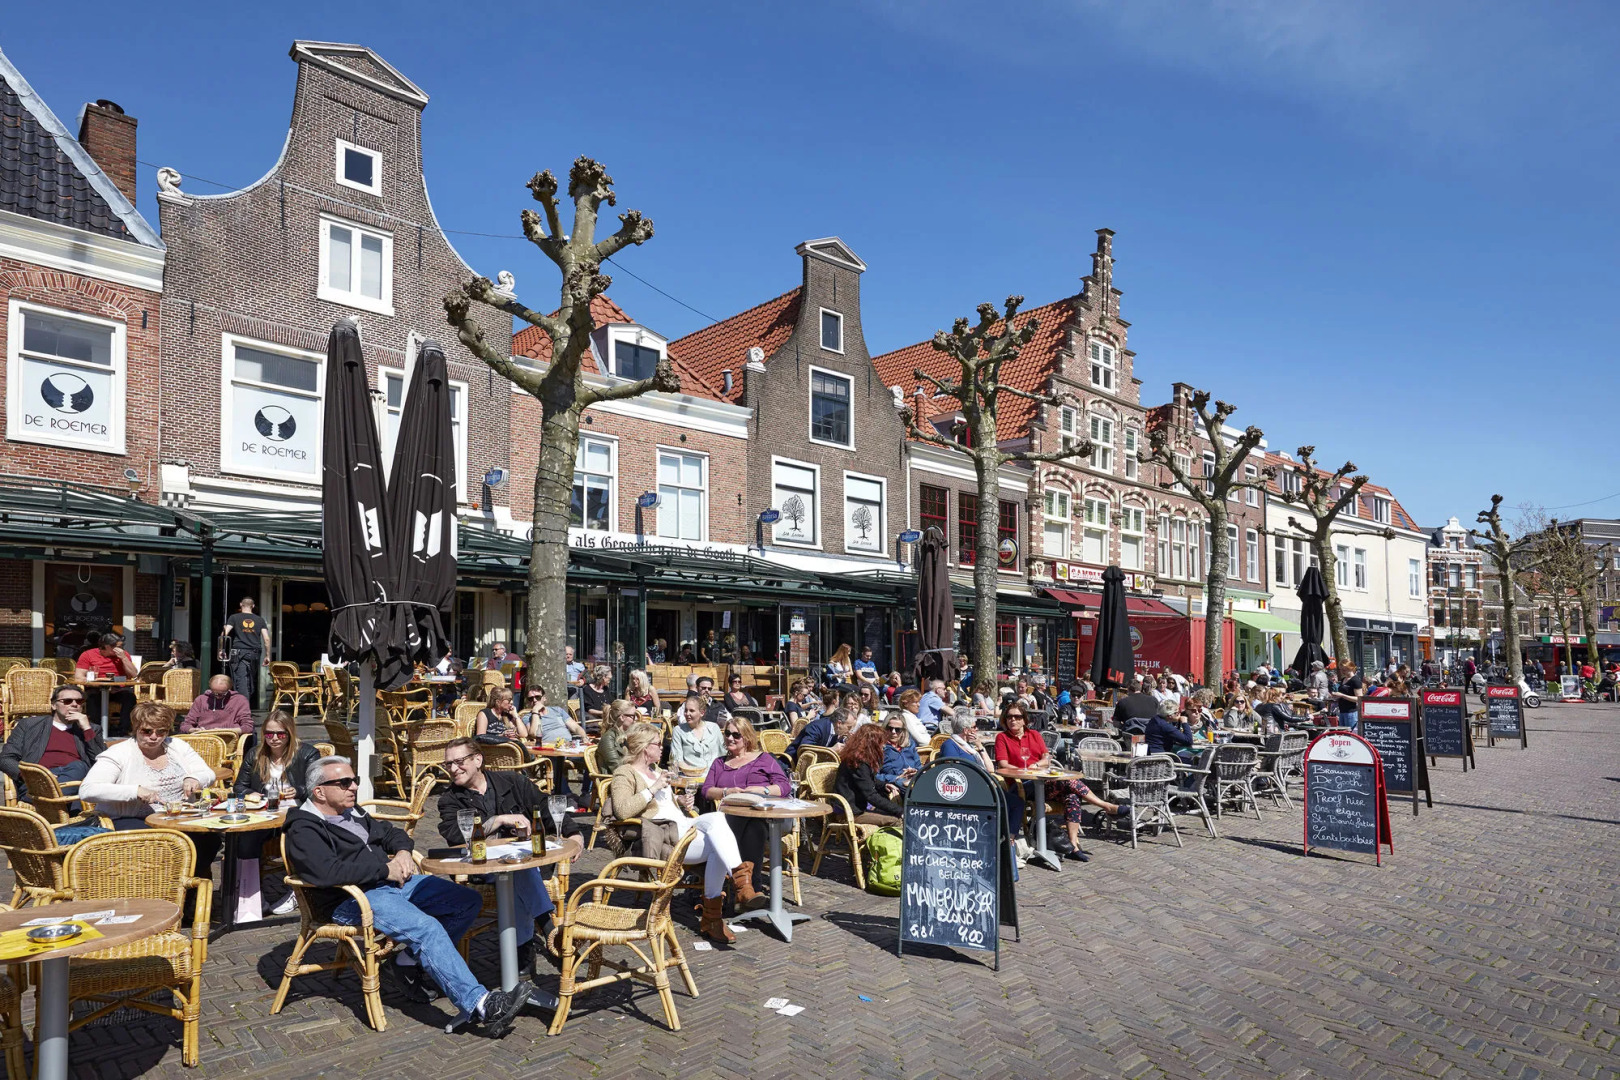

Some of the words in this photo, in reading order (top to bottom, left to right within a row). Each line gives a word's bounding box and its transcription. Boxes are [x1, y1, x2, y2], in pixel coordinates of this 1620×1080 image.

[24, 413, 43, 427] DE
[50, 418, 107, 436] ROEMER
[242, 442, 257, 453] DE
[262, 445, 307, 460] ROEMER
[575, 533, 596, 548] als
[1553, 636, 1578, 644] VENZIA
[1328, 738, 1352, 747] Jopen
[940, 782, 964, 794] Jopen
[1311, 775, 1332, 785] De
[1335, 775, 1363, 789] Gooth
[1314, 791, 1342, 807] Proef
[1346, 795, 1366, 806] hier
[909, 808, 930, 818] CAFE
[934, 811, 943, 819] DE
[947, 812, 980, 822] ROEMER
[1336, 808, 1363, 818] eigen
[918, 823, 939, 845] OP
[943, 825, 978, 849] TAP
[909, 854, 957, 868] MECHELS
[906, 882, 994, 918] MANEBLUSSER
[936, 909, 974, 926] BLOND
